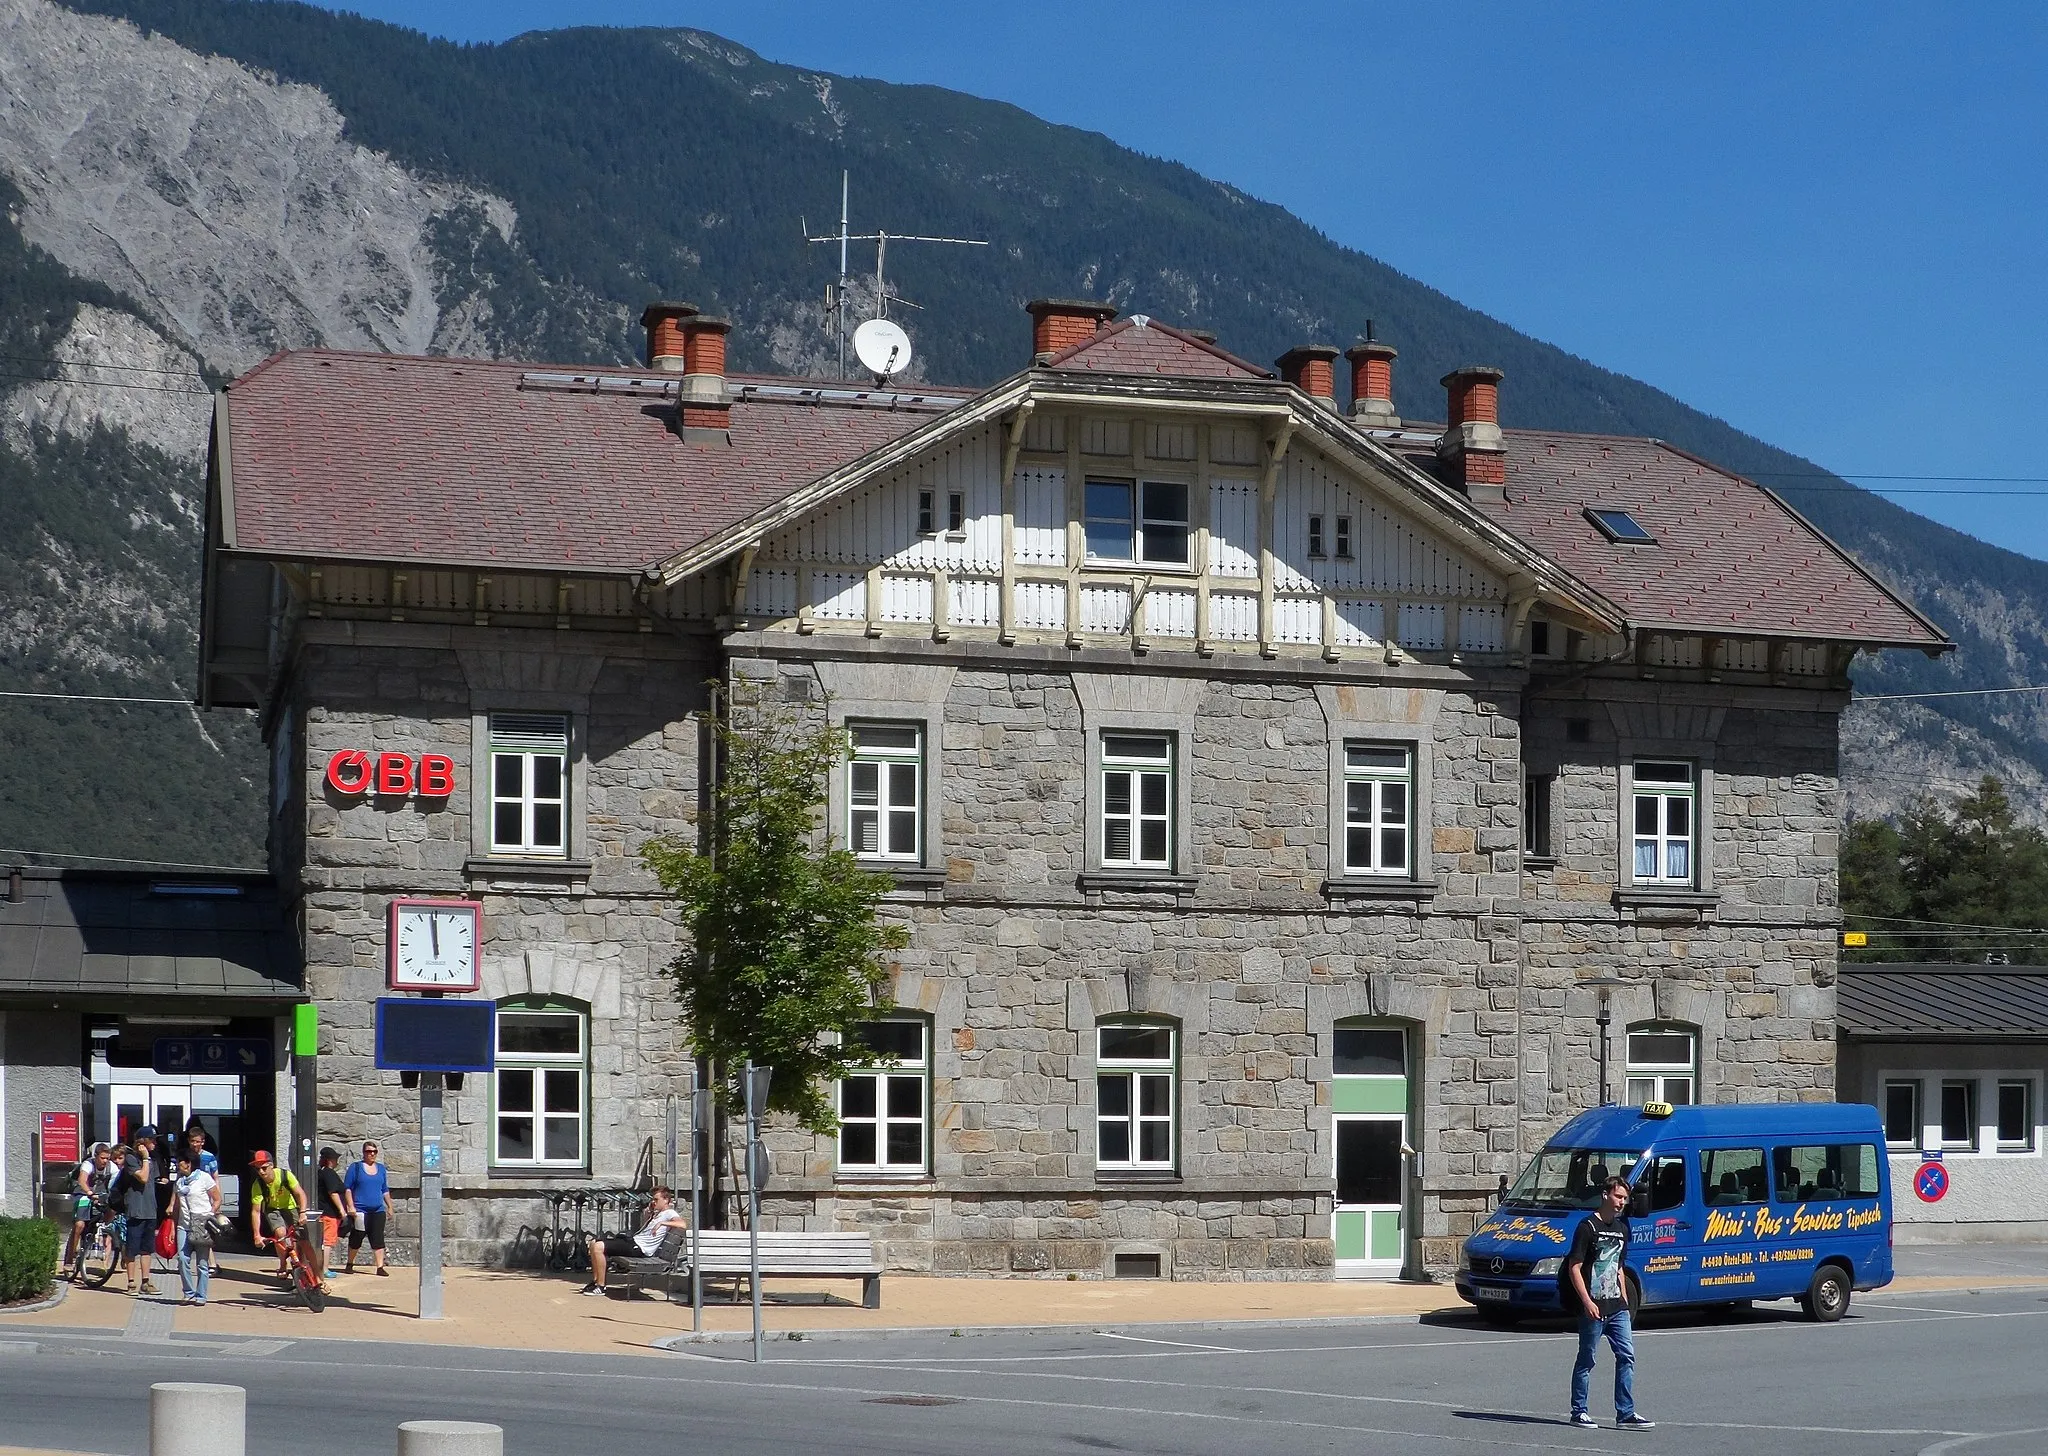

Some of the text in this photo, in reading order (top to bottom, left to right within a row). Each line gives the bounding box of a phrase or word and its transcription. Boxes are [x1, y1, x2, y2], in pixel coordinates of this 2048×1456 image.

[328, 748, 455, 797] ÖBB
[1645, 1104, 1667, 1114] TAXI
[1631, 1224, 1654, 1232] AUSTRIA
[1703, 1201, 1881, 1243] Mini Bus Service Tipotsch
[1475, 1217, 1567, 1244] Mini Bus Service
[1493, 1230, 1534, 1242] Tipotsch
[1632, 1231, 1653, 1244] TAXI
[1654, 1225, 1676, 1238] 88216
[1702, 1256, 1723, 1269] A-6430
[1759, 1250, 1770, 1263] Tel.
[1700, 1271, 1756, 1286] www.austriataxi.info
